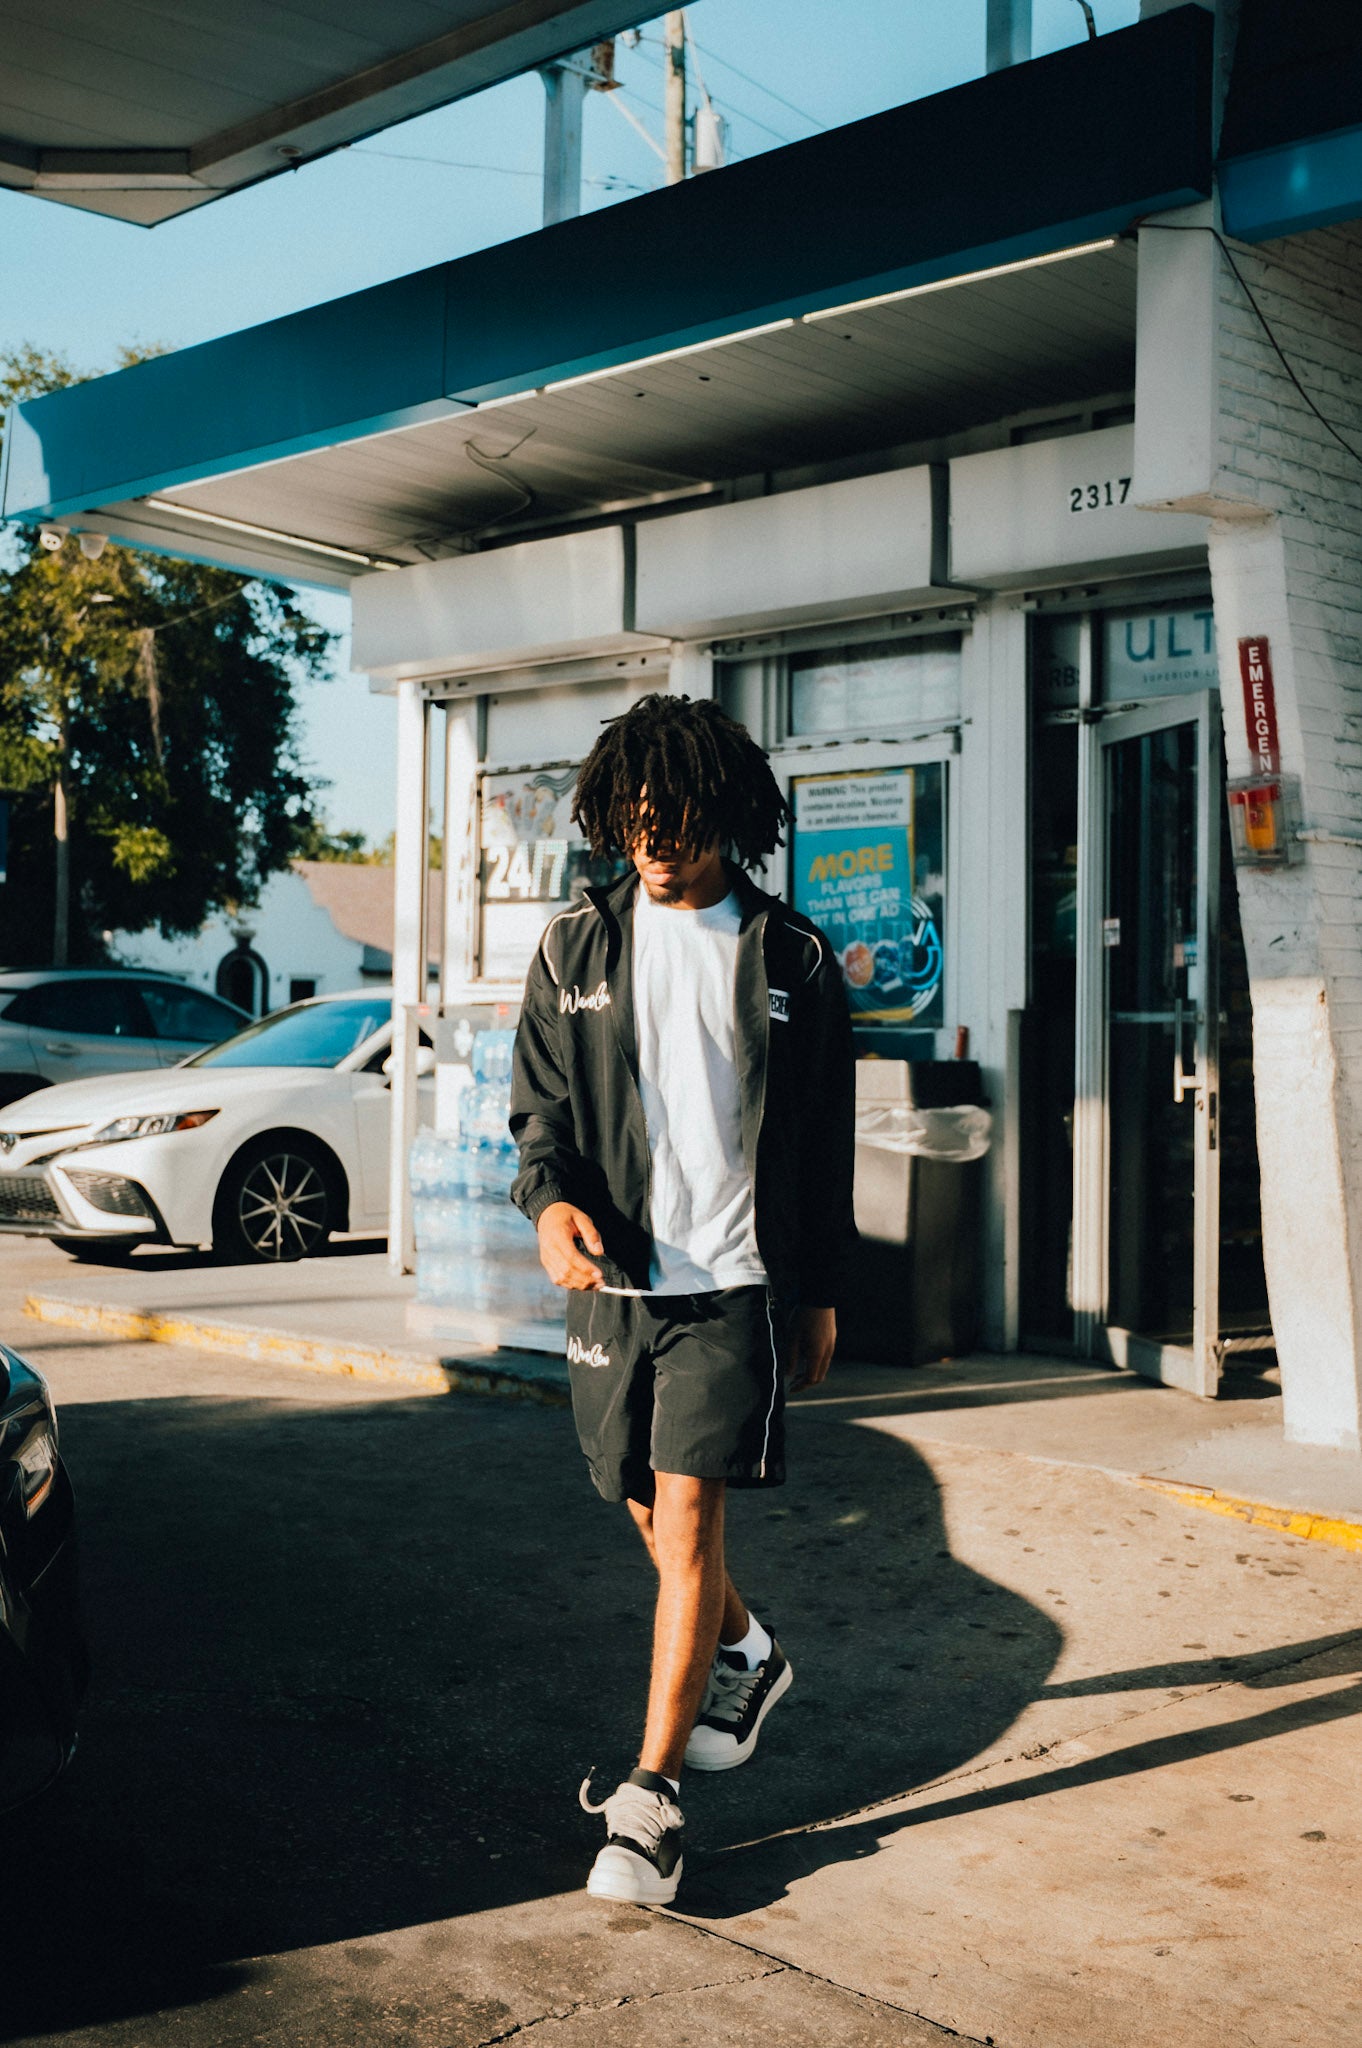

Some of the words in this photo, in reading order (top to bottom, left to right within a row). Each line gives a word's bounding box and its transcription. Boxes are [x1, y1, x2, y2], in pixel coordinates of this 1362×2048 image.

[1070, 477, 1132, 513] 2317
[1248, 646, 1273, 777] EMERGEN
[486, 838, 568, 898] 24/7
[808, 843, 894, 883] MORE
[807, 896, 843, 912] THAN
[845, 891, 867, 908] WE
[869, 887, 900, 905] CAN
[821, 872, 882, 896] FLAVORS
[880, 901, 900, 918] AD
